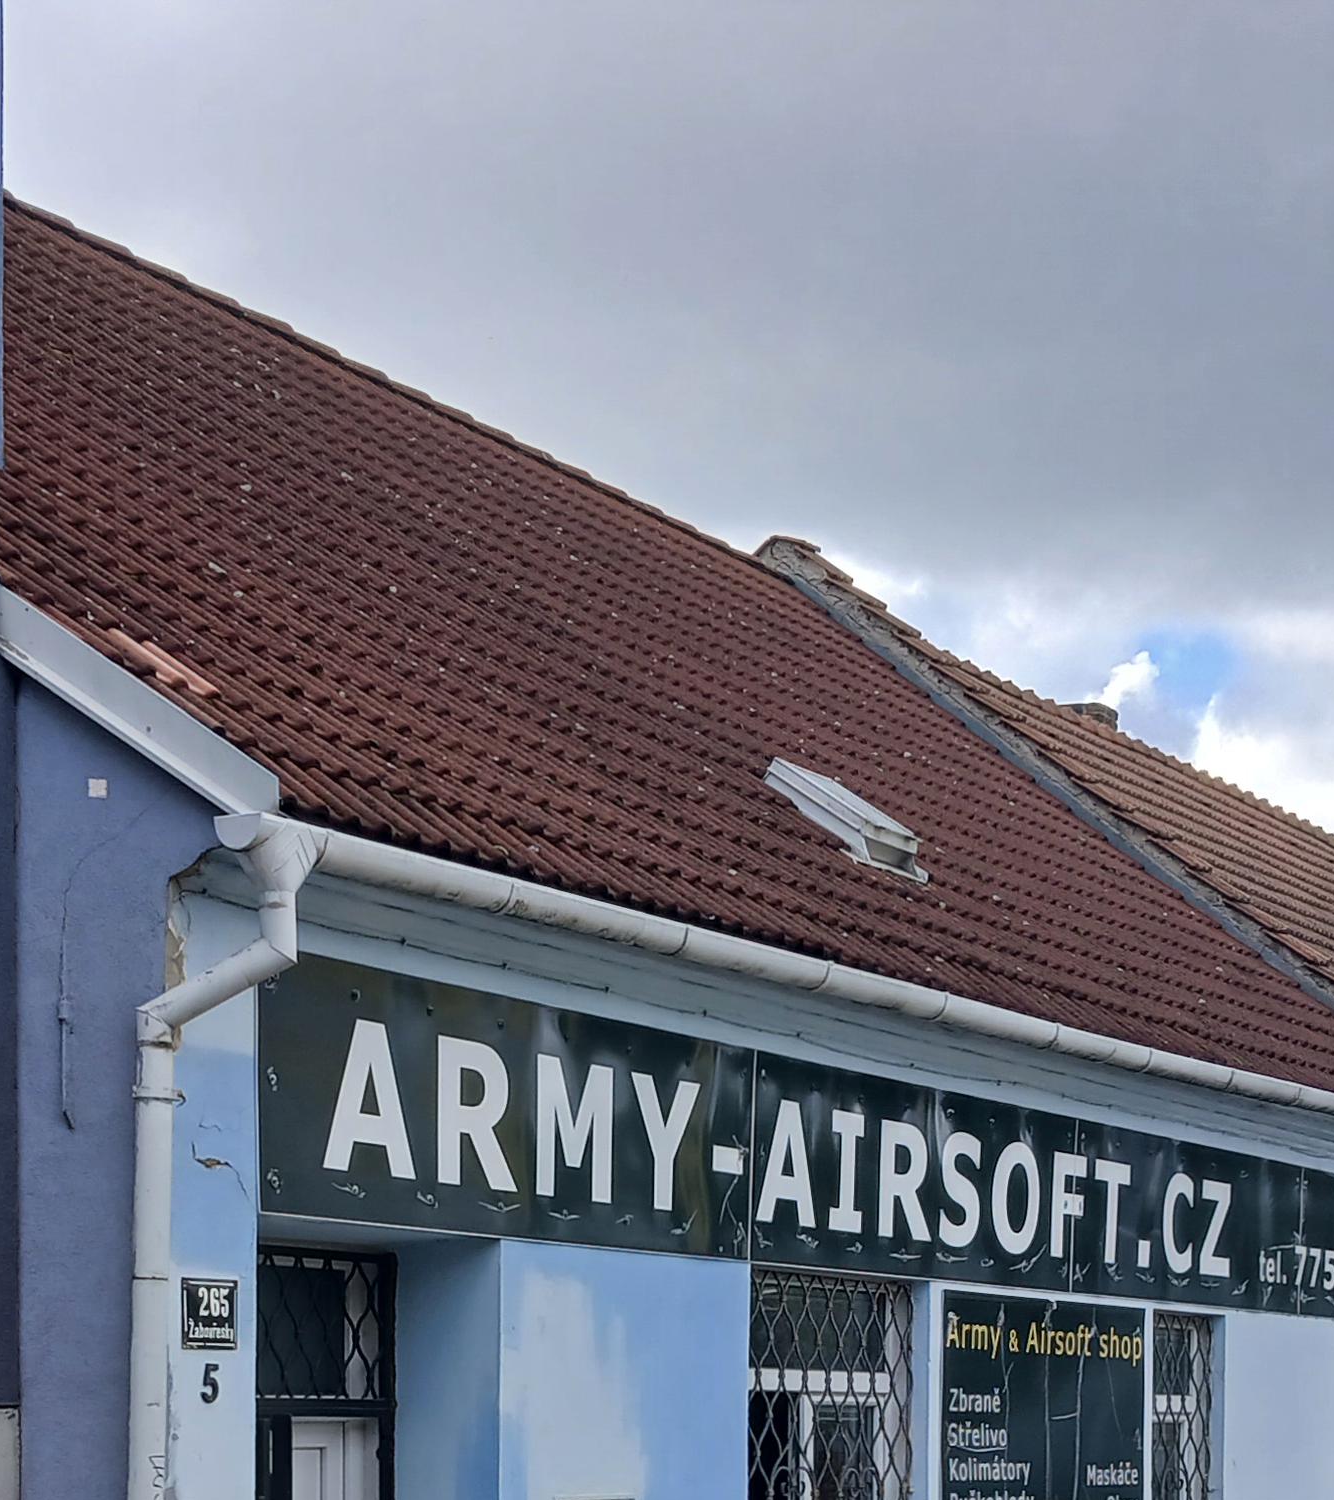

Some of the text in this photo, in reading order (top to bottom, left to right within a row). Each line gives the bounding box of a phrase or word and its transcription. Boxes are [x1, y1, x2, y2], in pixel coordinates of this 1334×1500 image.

[322, 1018, 1233, 1279] ARMY-AIRSOFT.CZ
[1259, 1250, 1287, 1284] tel.
[198, 1287, 229, 1318] 265
[946, 1320, 1142, 1367] Army & Airsoft shop
[200, 1363, 219, 1404] 5
[949, 1387, 1001, 1414] Zbraně
[948, 1421, 1008, 1447] Střelivo
[949, 1456, 1031, 1486] Kolimátory
[1086, 1462, 1138, 1487] Maskáče
